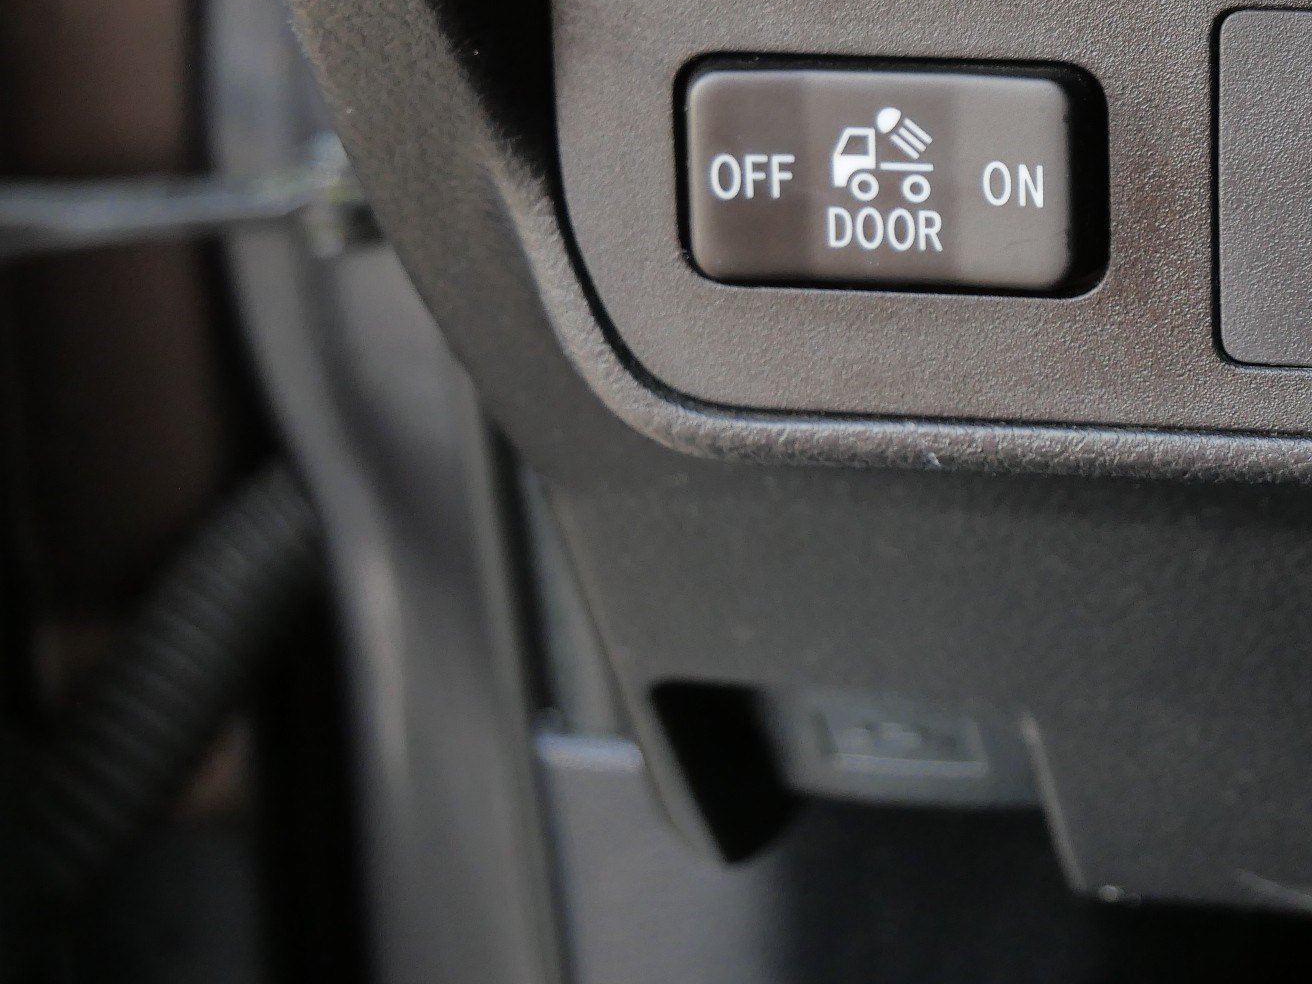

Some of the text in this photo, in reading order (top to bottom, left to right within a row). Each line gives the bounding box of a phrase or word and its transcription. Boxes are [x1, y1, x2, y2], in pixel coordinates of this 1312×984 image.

[709, 153, 795, 200] OFF
[981, 160, 1044, 208] ON
[827, 206, 943, 252] DOOR
